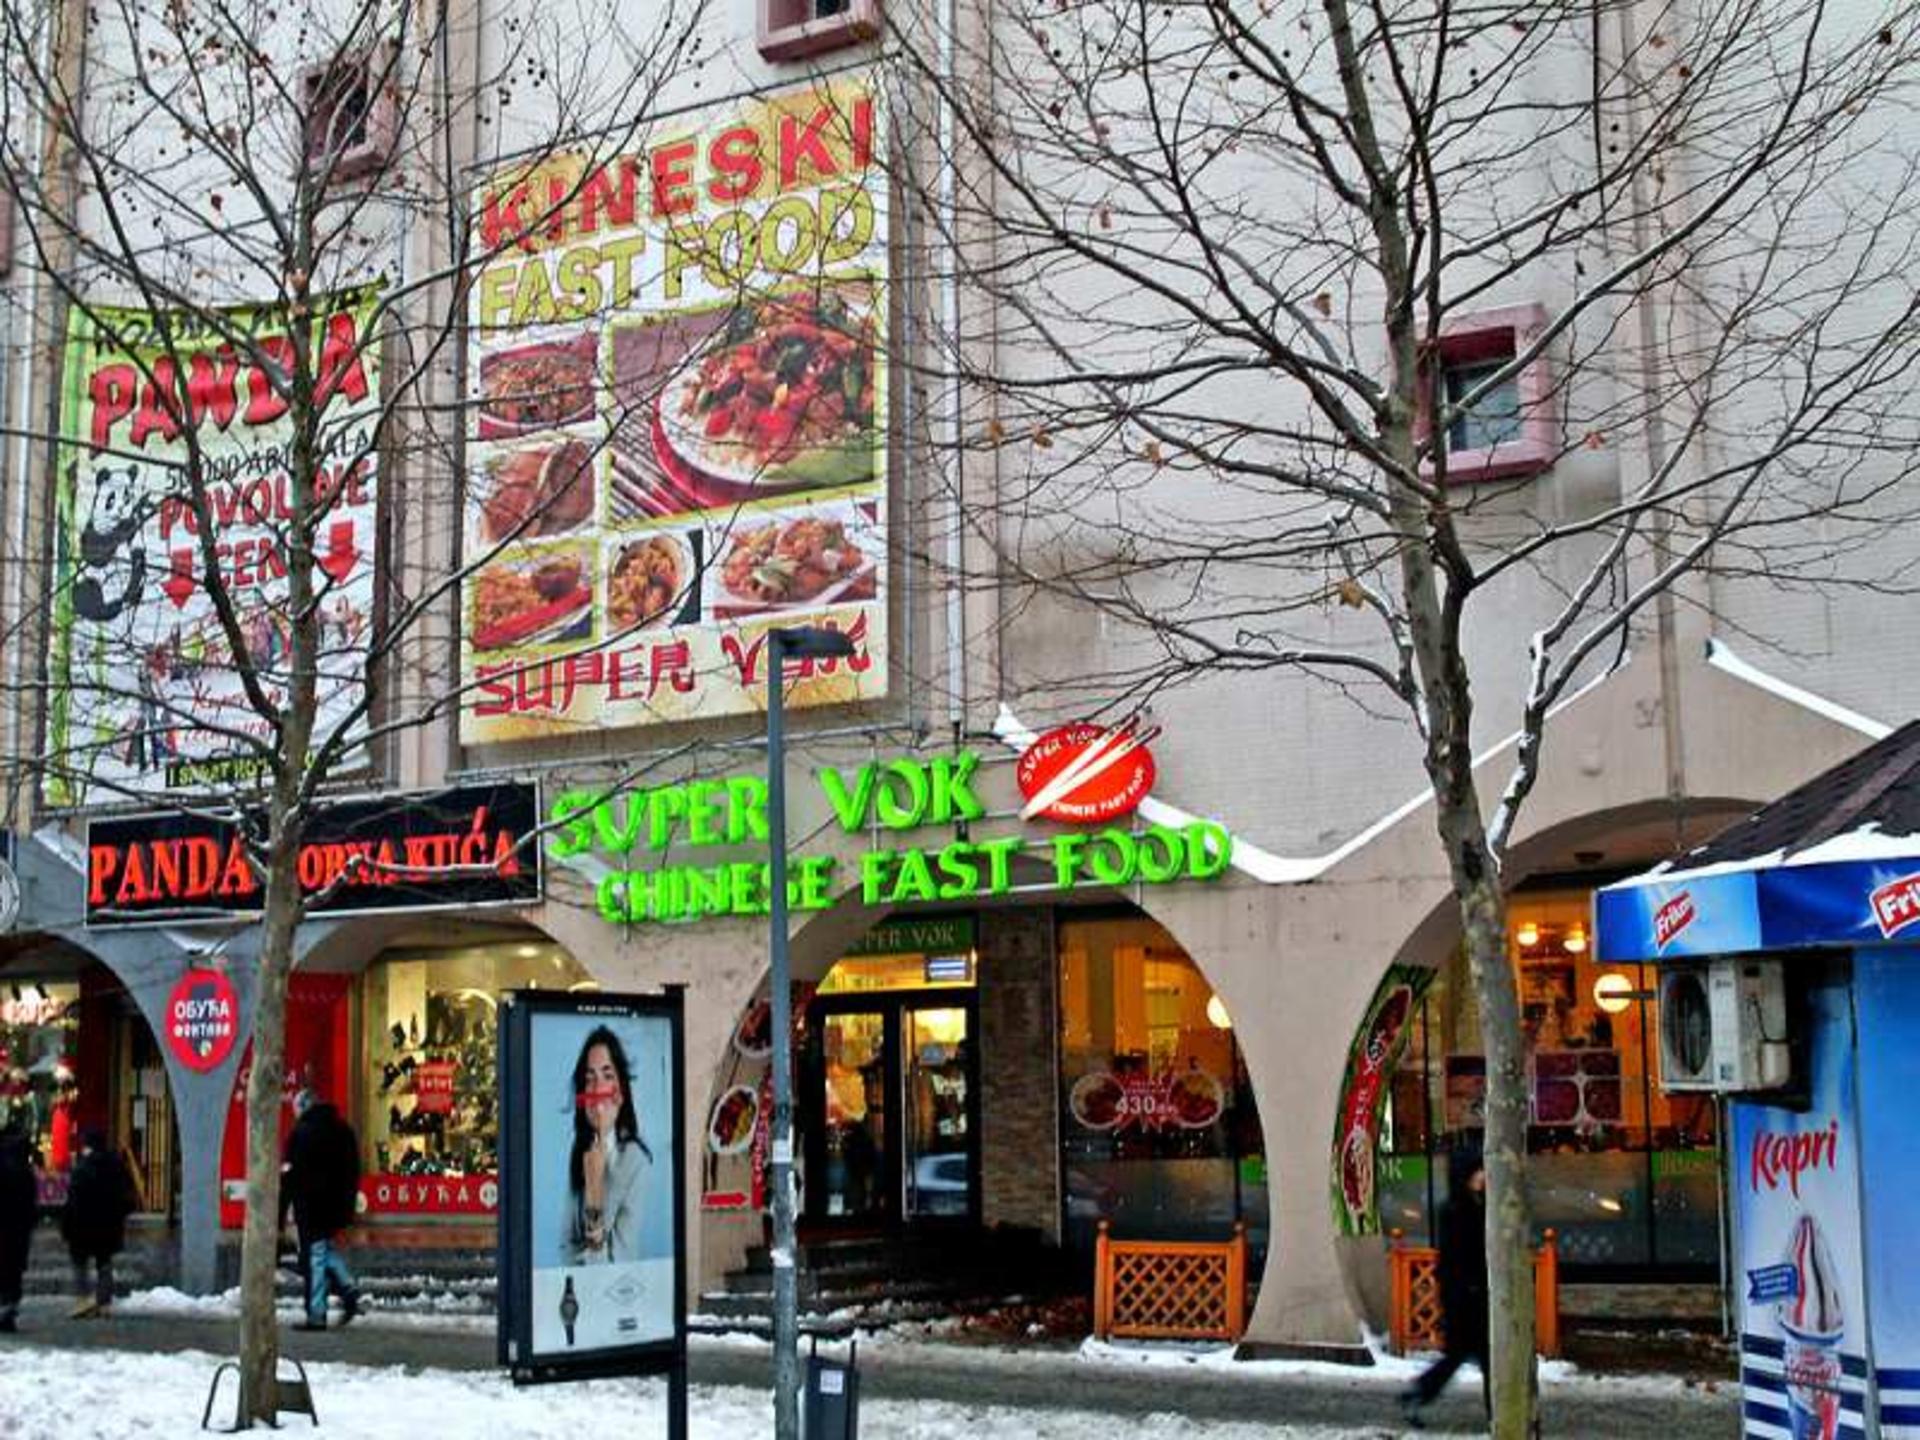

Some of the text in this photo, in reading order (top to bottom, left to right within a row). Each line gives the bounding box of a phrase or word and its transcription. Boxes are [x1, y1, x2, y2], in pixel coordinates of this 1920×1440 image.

[479, 100, 873, 252] KINESKI
[480, 189, 873, 326] FAST FOOD
[89, 312, 370, 460] PANDA
[213, 537, 292, 588] CEN
[474, 638, 695, 717] SUPER
[550, 750, 985, 857] SUPER VOK
[90, 836, 257, 906] PANDA
[403, 805, 522, 884] KUĆA
[862, 834, 1024, 905] FAST
[1051, 818, 1233, 890] FOOD
[174, 999, 230, 1020] ОБУЋА
[376, 1183, 470, 1205] ОБУЋА
[1751, 1120, 1839, 1200] Kapri
